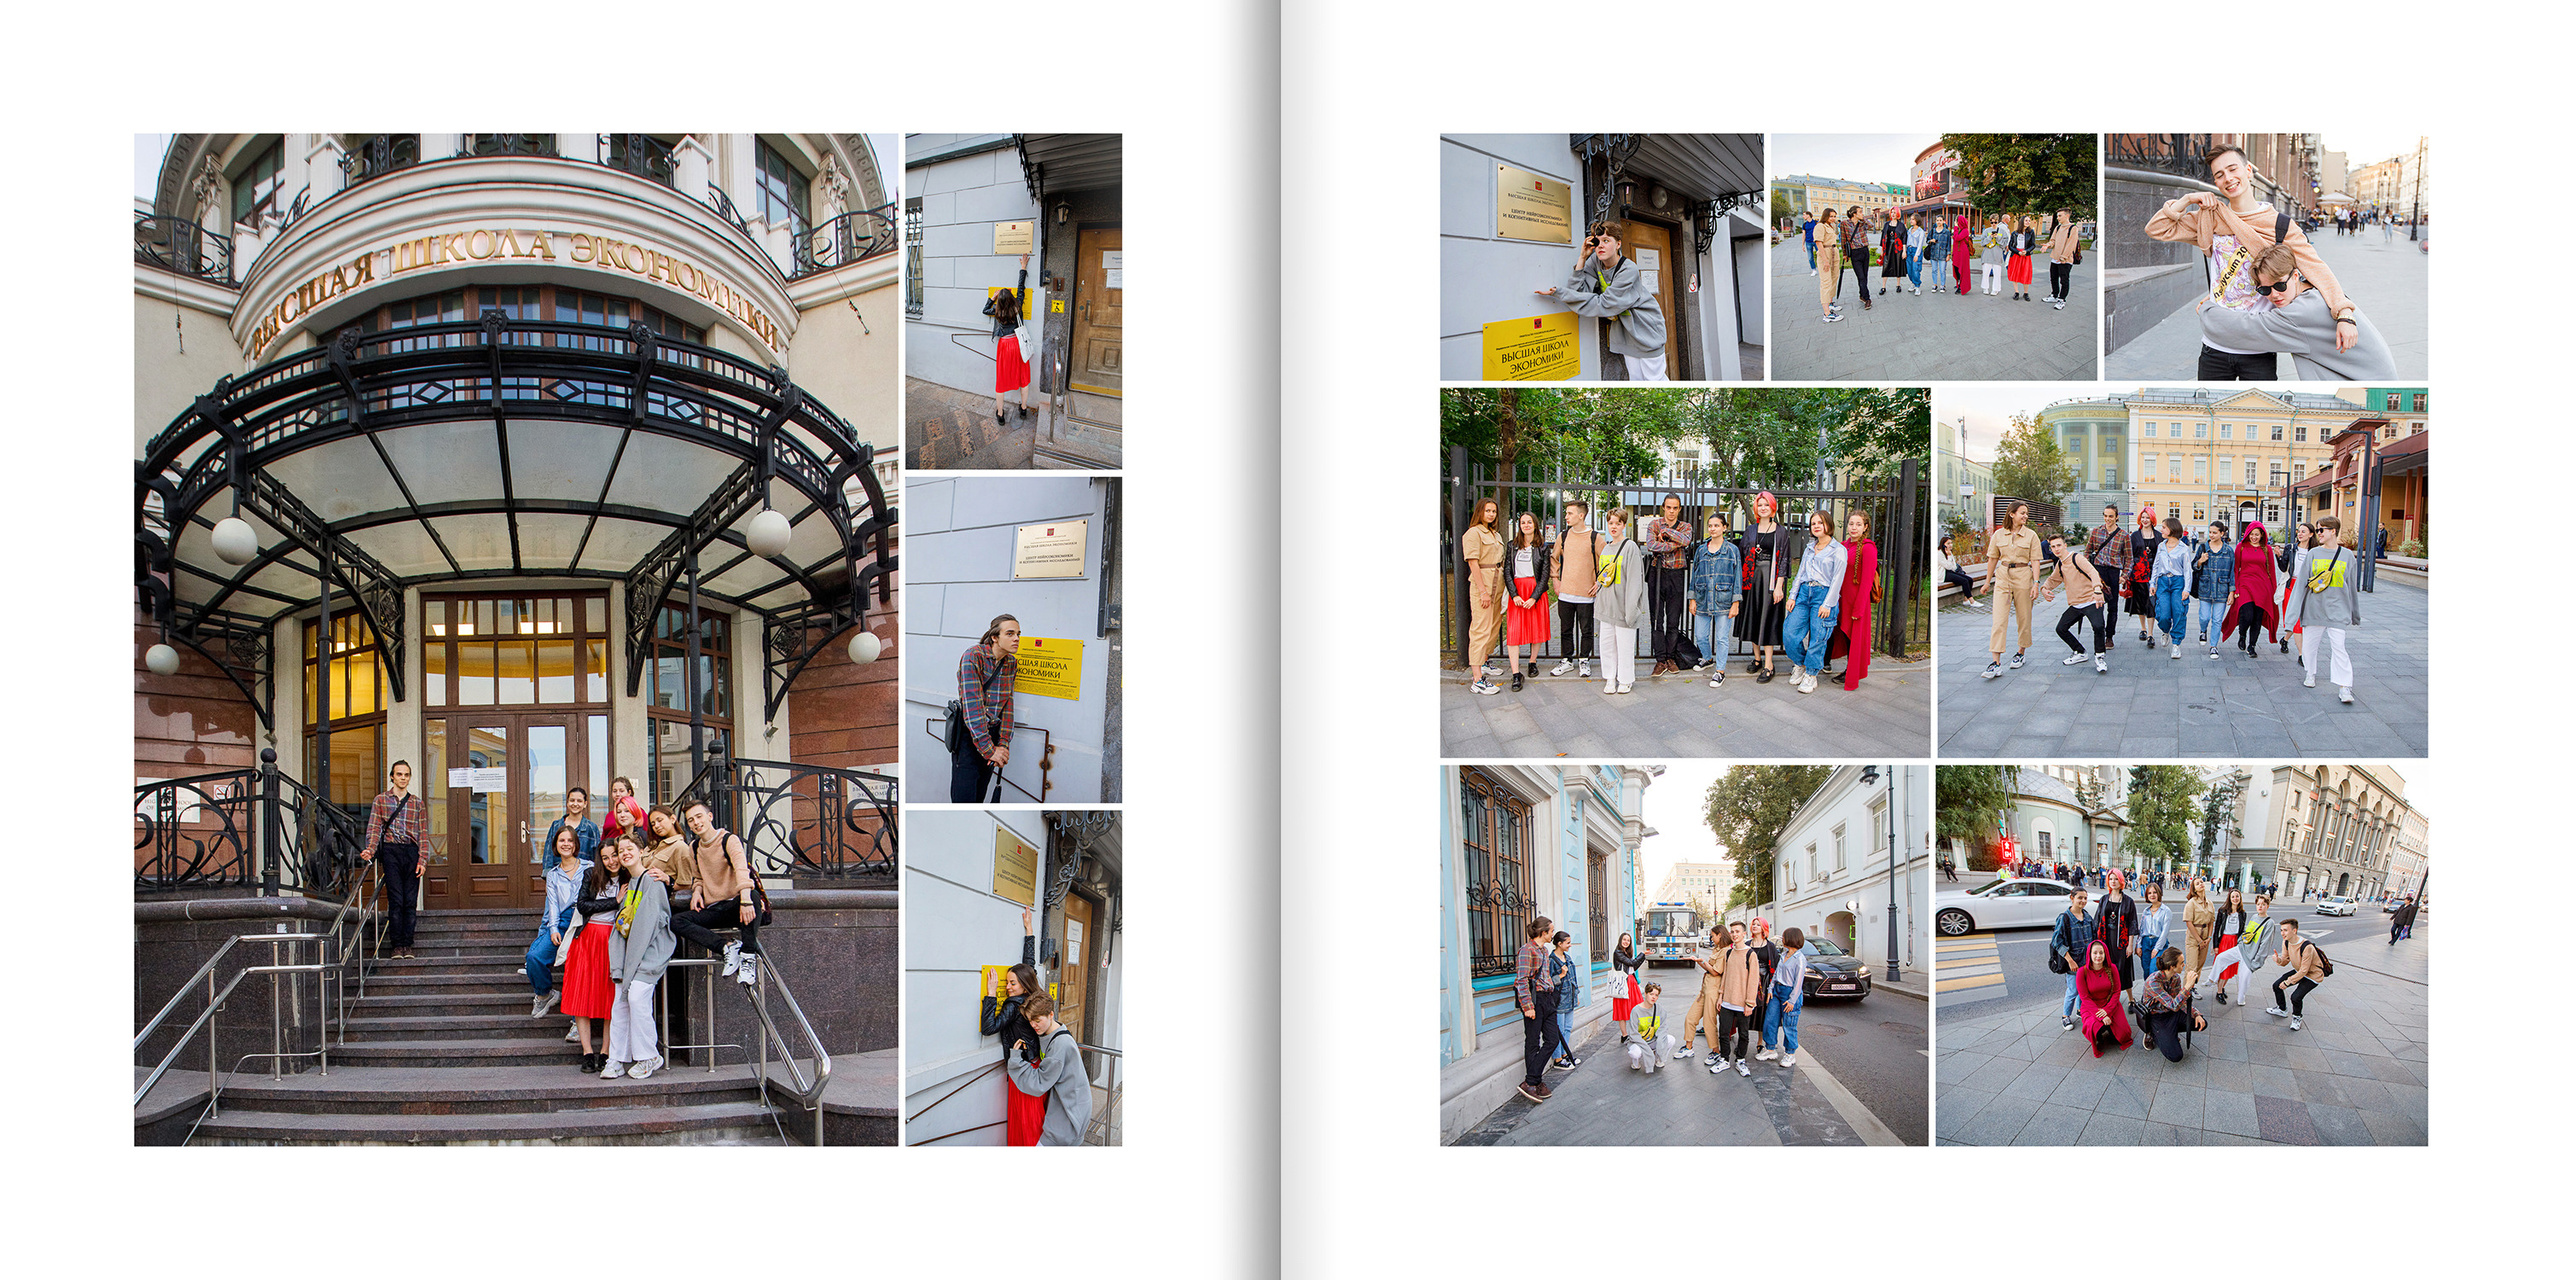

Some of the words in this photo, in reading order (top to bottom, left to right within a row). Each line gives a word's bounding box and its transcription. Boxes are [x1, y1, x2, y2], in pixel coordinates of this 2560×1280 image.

[2220, 259, 2241, 287] lyceum
[251, 251, 375, 360] ВЫСШАЯ
[392, 228, 556, 273] ШКОЛА
[570, 232, 779, 353] ЭКОНОМИКИ
[1501, 345, 1541, 364] ВЫСШАЯ
[1542, 340, 1570, 353] ШКОЛА
[1509, 351, 1564, 375] ЭКОНОМИКИ
[1017, 667, 1061, 679] КОНОМИКИ
[1040, 660, 1068, 671] ШКОЛА
